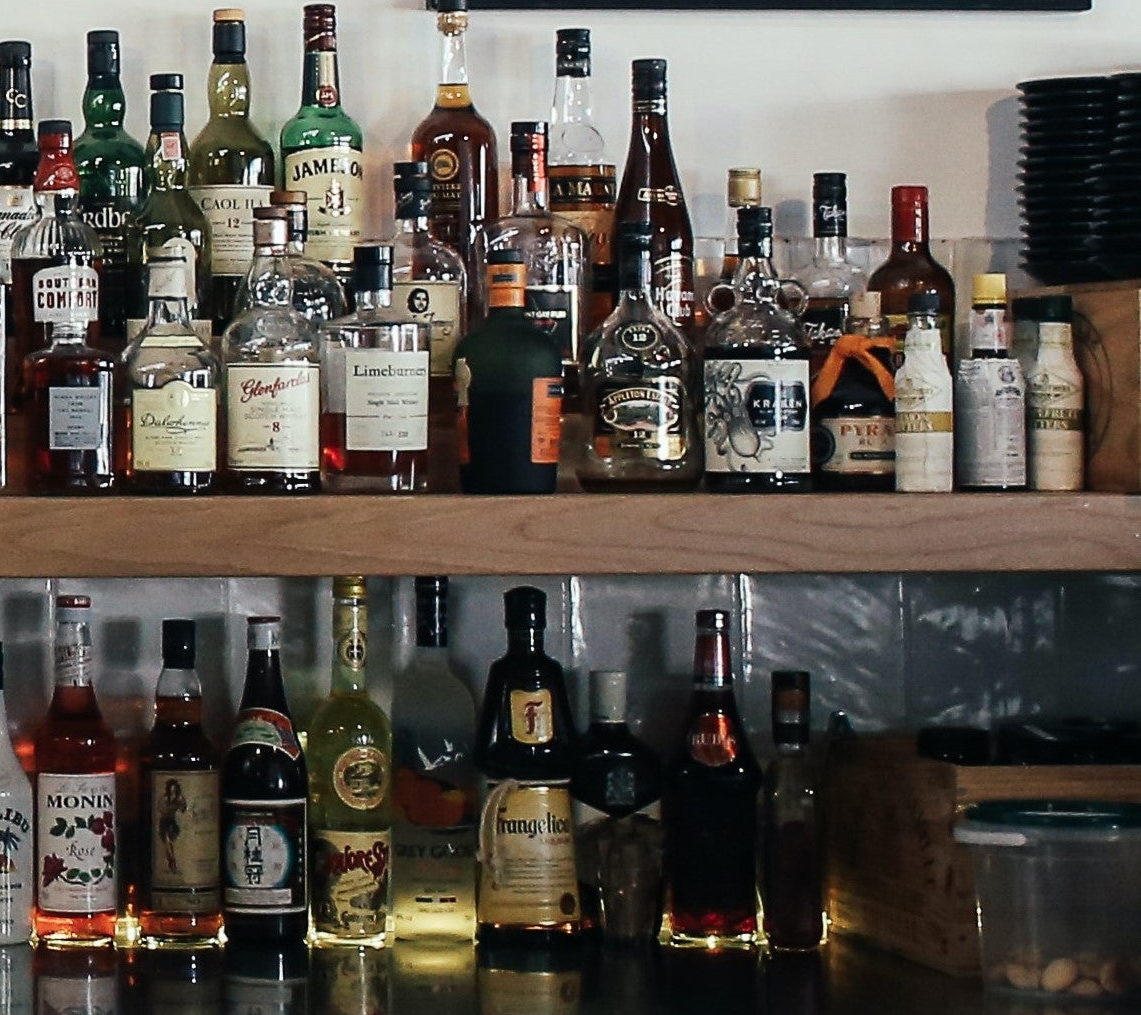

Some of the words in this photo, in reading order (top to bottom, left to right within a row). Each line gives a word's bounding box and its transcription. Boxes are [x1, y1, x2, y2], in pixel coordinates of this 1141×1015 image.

[293, 158, 363, 182] JAMEON
[201, 197, 241, 211] CAOL
[227, 217, 240, 230] 12
[271, 422, 280, 432] 8
[47, 793, 114, 809] MONIN
